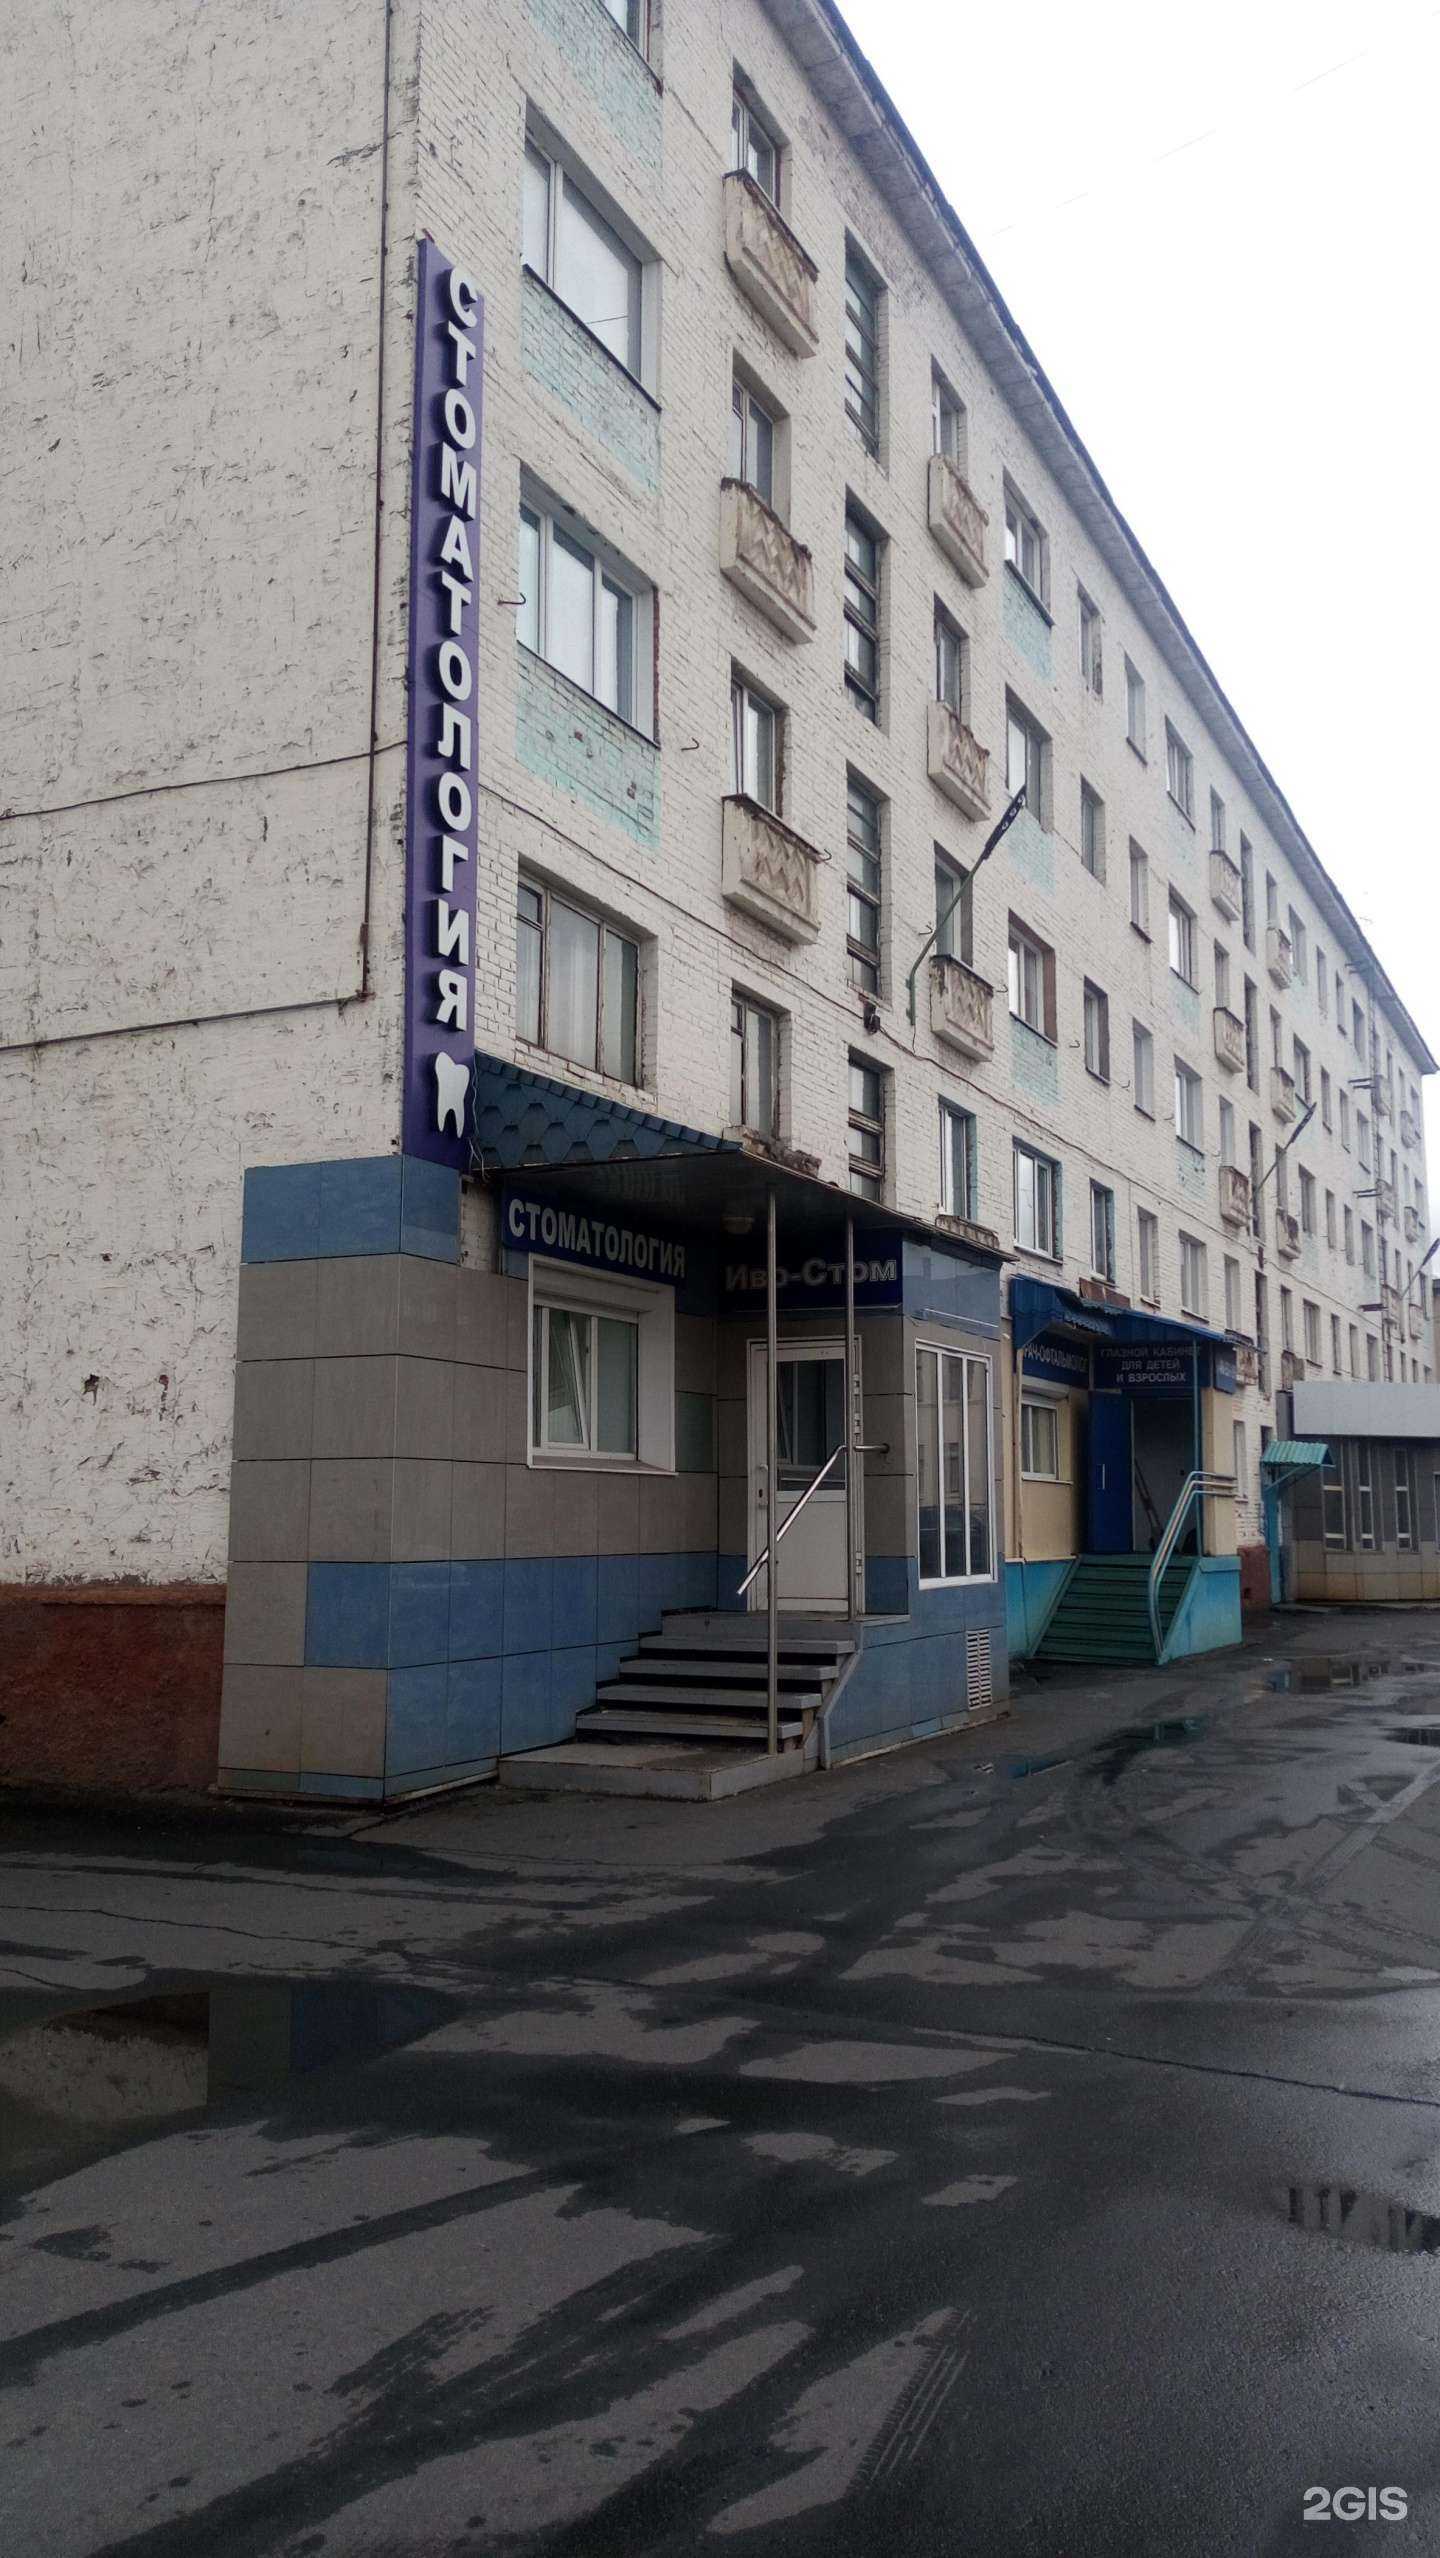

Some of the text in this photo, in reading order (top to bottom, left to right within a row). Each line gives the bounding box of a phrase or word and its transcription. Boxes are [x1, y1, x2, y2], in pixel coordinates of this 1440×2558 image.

[435, 265, 478, 1032] СТОМАТОЛОГИЯ
[508, 1199, 686, 1279] СТОМАТОЛОГИЯ
[1116, 1372, 1186, 1383] И ВЗРОСЛЫХ
[1121, 1358, 1181, 1371] ДЛЯ ДЕТЕЙ
